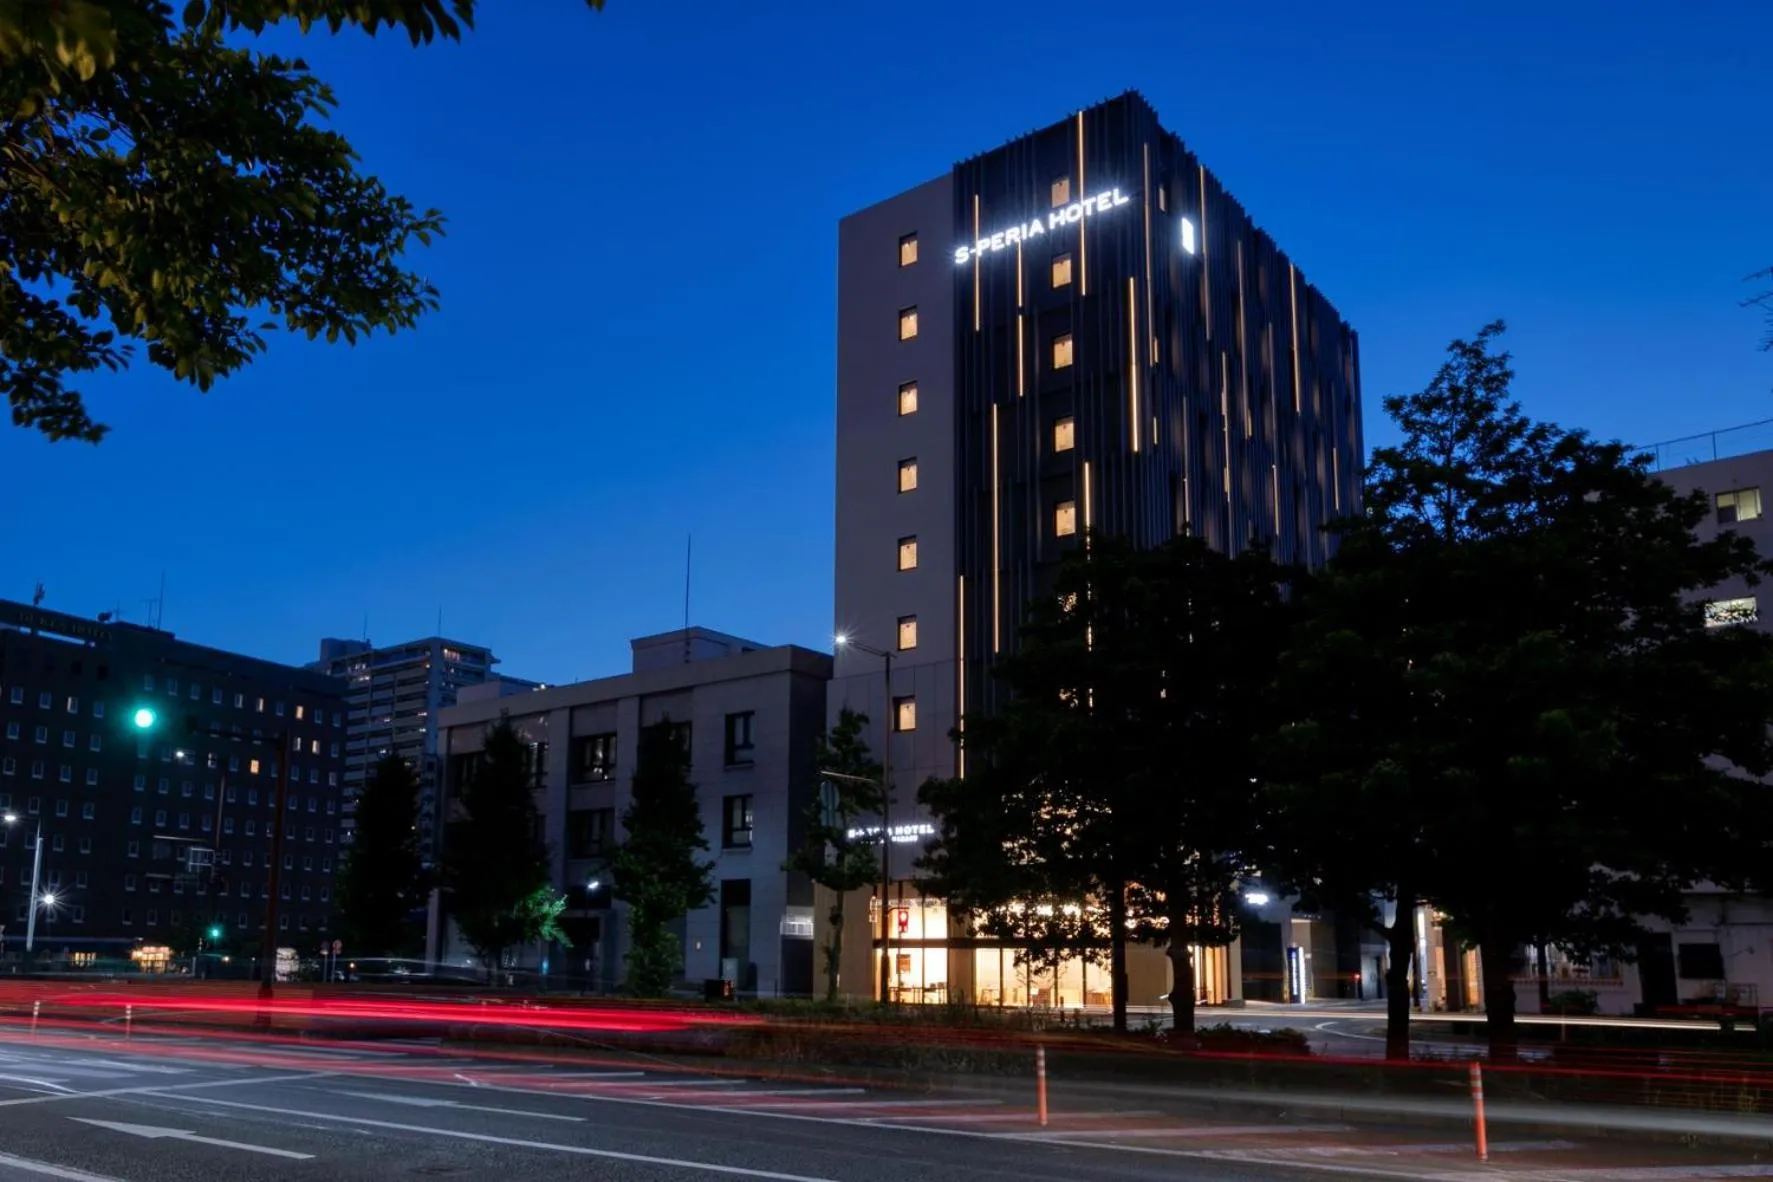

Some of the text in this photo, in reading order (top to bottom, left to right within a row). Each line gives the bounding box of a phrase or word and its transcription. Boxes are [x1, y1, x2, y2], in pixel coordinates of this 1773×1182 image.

[954, 187, 1129, 264] S-PERIA HOTEL
[895, 823, 935, 835] HOTEL
